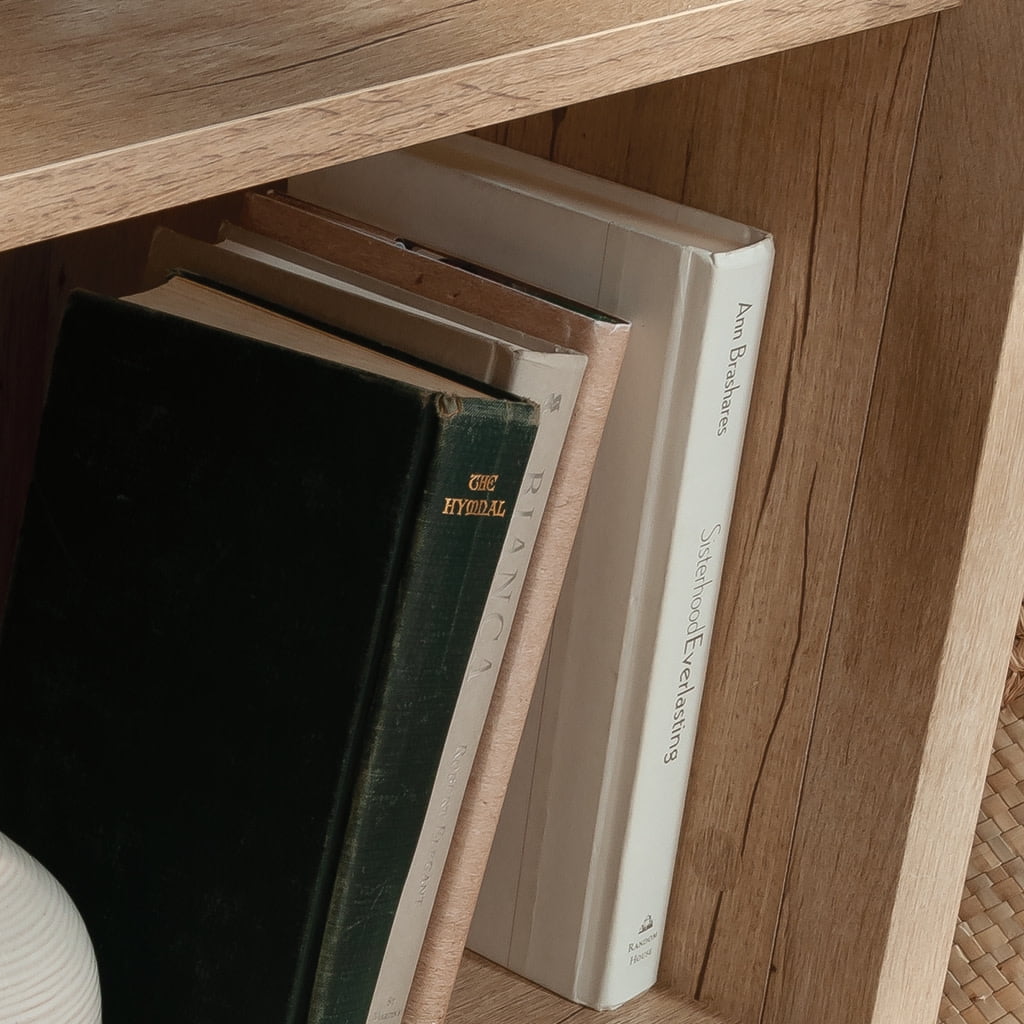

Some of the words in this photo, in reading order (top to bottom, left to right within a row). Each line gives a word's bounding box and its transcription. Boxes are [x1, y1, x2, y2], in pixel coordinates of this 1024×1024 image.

[733, 302, 752, 341] Ann
[717, 344, 746, 437] Brashares
[467, 473, 499, 491] THE
[442, 497, 506, 517] HYMNAL
